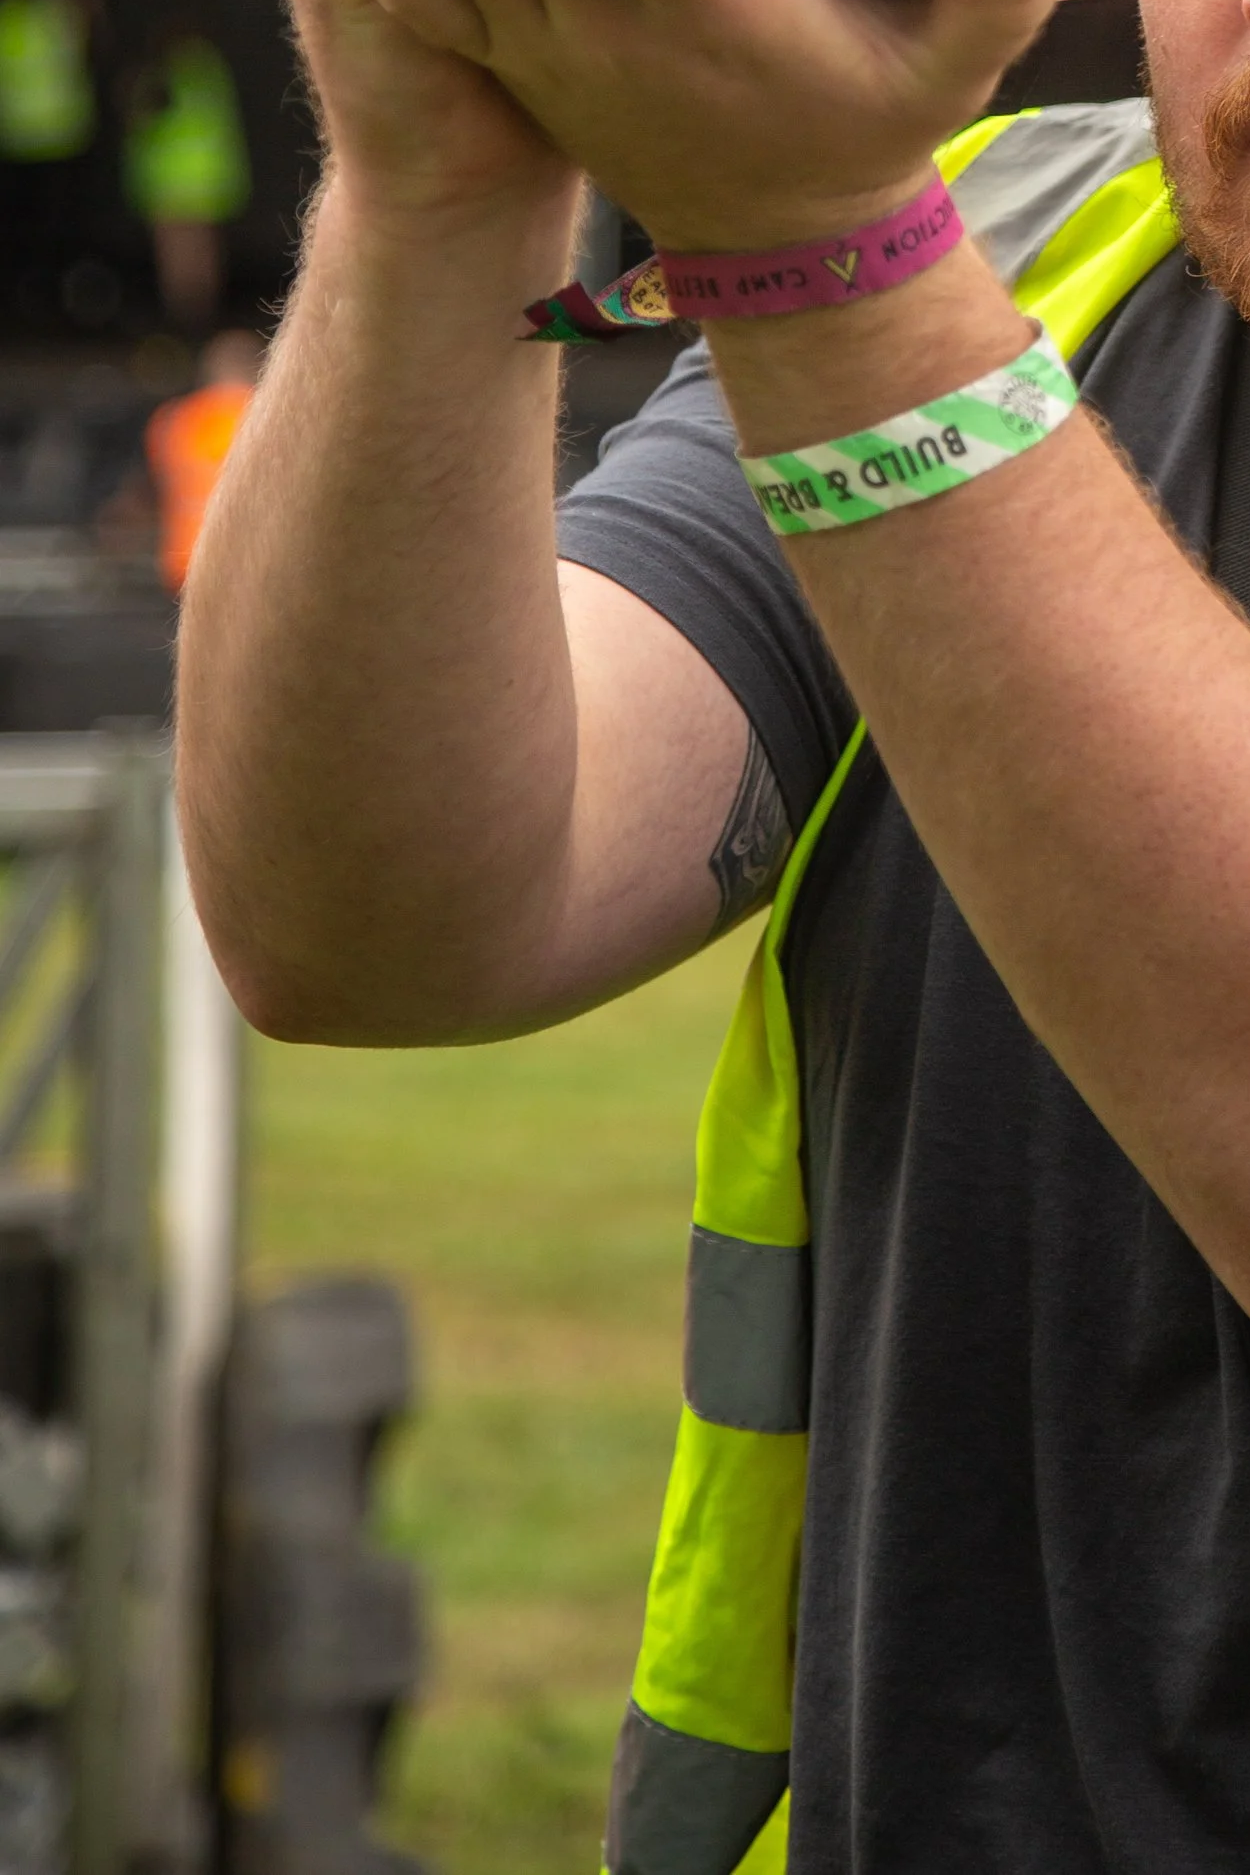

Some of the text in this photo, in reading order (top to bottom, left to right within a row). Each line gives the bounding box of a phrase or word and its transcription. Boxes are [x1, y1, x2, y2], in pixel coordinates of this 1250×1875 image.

[736, 268, 807, 296] CAMP
[757, 424, 968, 516] BUILD & BREA
